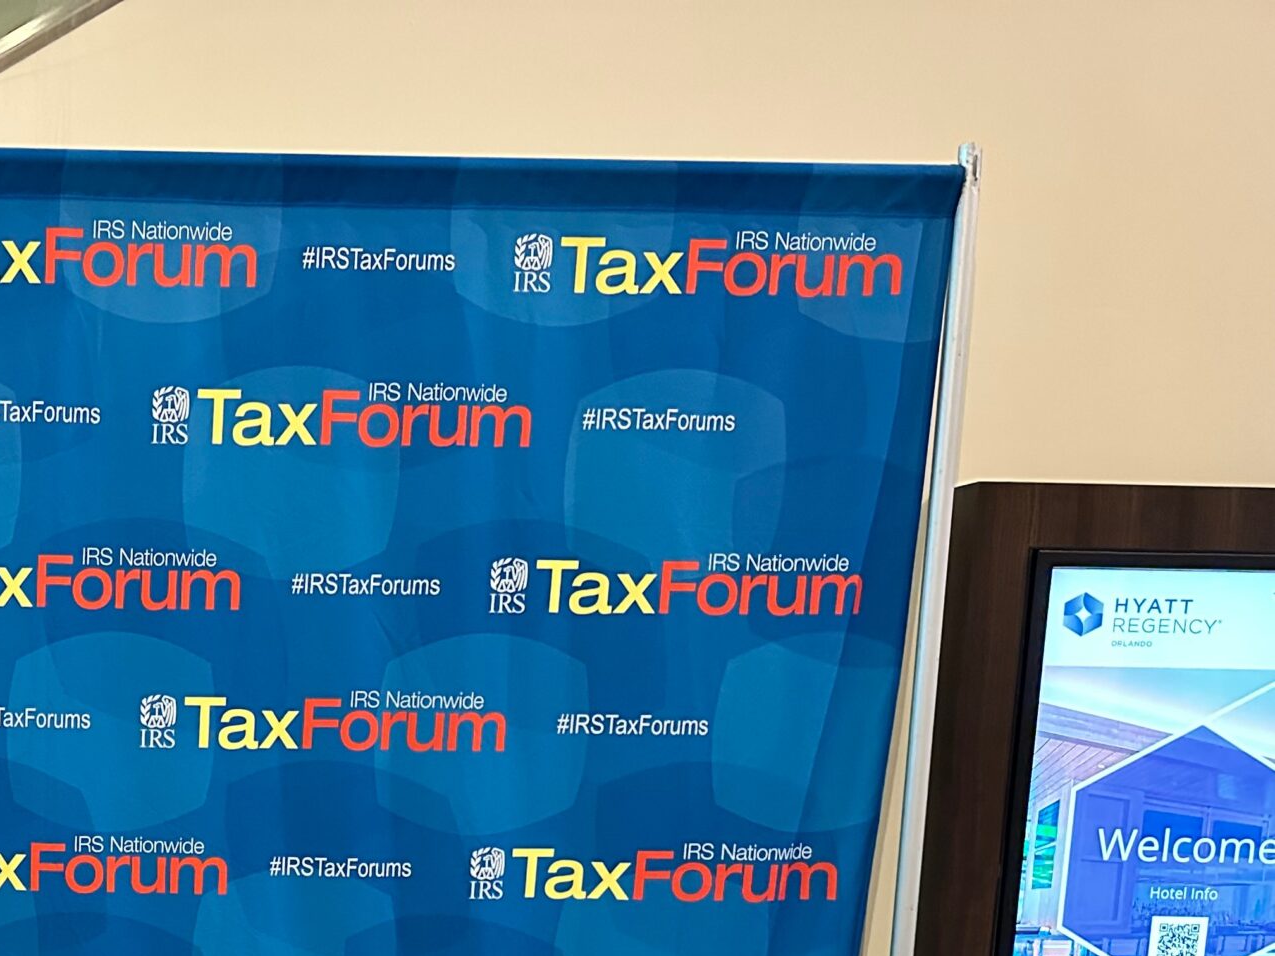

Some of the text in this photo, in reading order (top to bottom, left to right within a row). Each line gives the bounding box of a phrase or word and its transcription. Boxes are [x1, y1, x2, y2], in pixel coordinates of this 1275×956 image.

[93, 219, 233, 242] IRS Nationwide
[735, 230, 877, 252] IRS Nationwide
[302, 246, 456, 271] #IRSTaxForums
[561, 236, 903, 298] TaxForum
[513, 271, 551, 293] IRS
[368, 382, 508, 403] IRS Nationwide
[197, 389, 532, 448] TaxForum
[582, 407, 736, 432] #IRSTaxForums
[151, 423, 189, 445] IRS
[82, 547, 217, 567] IRS Nationwide
[708, 553, 850, 572] IRS Nationwide
[291, 573, 441, 596] #IRSTaxForums
[536, 559, 863, 617] TaxForum
[489, 591, 526, 614] IRS
[1115, 598, 1193, 614] HYATT
[1111, 640, 1153, 648] ORLANDO
[350, 690, 485, 710] IRS Nationwide
[184, 696, 506, 752] TaxForum
[556, 713, 709, 736] #IRSTaxForums
[140, 728, 176, 749] IRS
[74, 835, 205, 855] IRS Nationwide
[683, 842, 813, 862] IRS Nationwide
[1098, 828, 1275, 864] Welcome
[269, 856, 412, 878] #IRSTaxForums
[512, 848, 838, 903] TaxForum
[469, 878, 504, 900] IRS
[1150, 886, 1218, 900] Hotel Info
